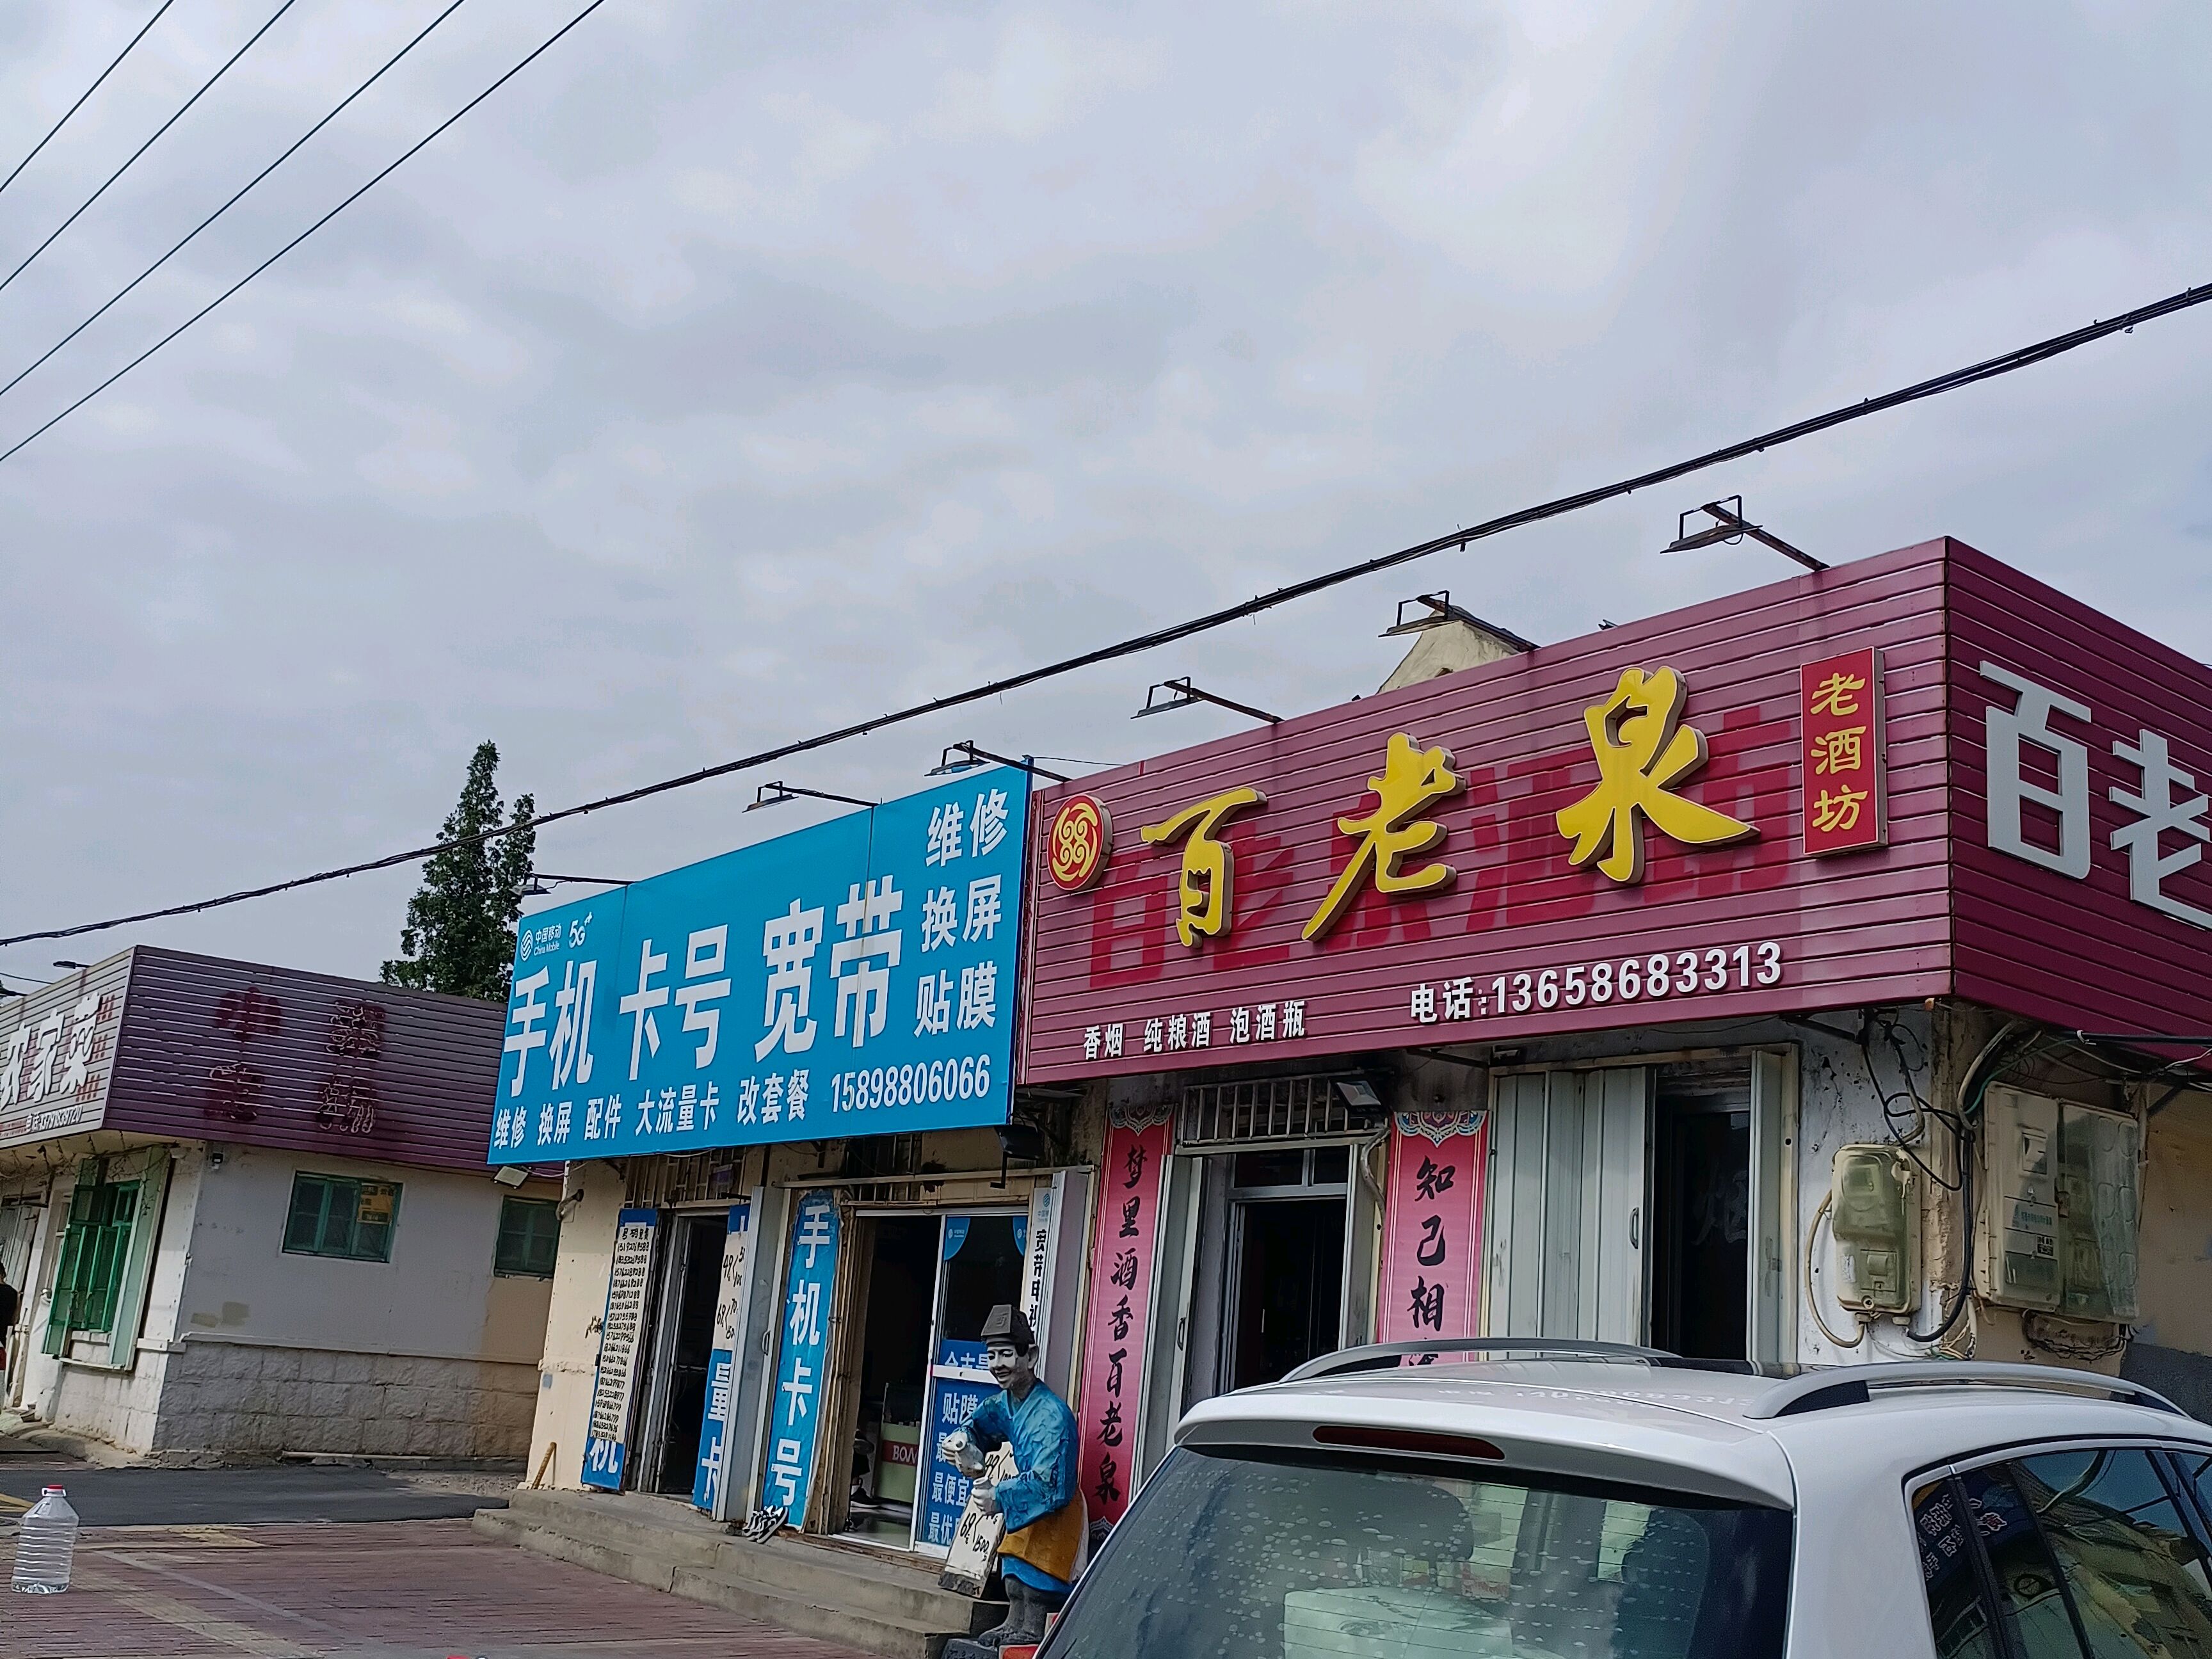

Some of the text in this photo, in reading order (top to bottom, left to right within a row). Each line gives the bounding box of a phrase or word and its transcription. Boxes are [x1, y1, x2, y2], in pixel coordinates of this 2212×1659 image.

[1809, 671, 1868, 833] 老酒坊
[1980, 660, 2212, 931] 百老
[925, 788, 1009, 868] 维修
[1141, 665, 1760, 949] 百老泉
[534, 940, 560, 956] China Mobile
[535, 923, 561, 944] 中国移动
[920, 874, 1002, 953] 换屏
[504, 960, 597, 1098] 手机
[618, 924, 732, 1082] 卡号
[755, 874, 904, 1063] 宽带
[914, 960, 998, 1038] 贴膜
[1083, 1000, 1306, 1060] 香烟 纯粮酒 泡酒瓶
[493, 1054, 990, 1150] 维修 换屏 配件 大流量卡 改套餐 15898806066
[771, 1205, 830, 1507] 手机卡号
[1093, 1145, 1148, 1502] 梦里酒香百老泉
[932, 1471, 970, 1507] 最便宜
